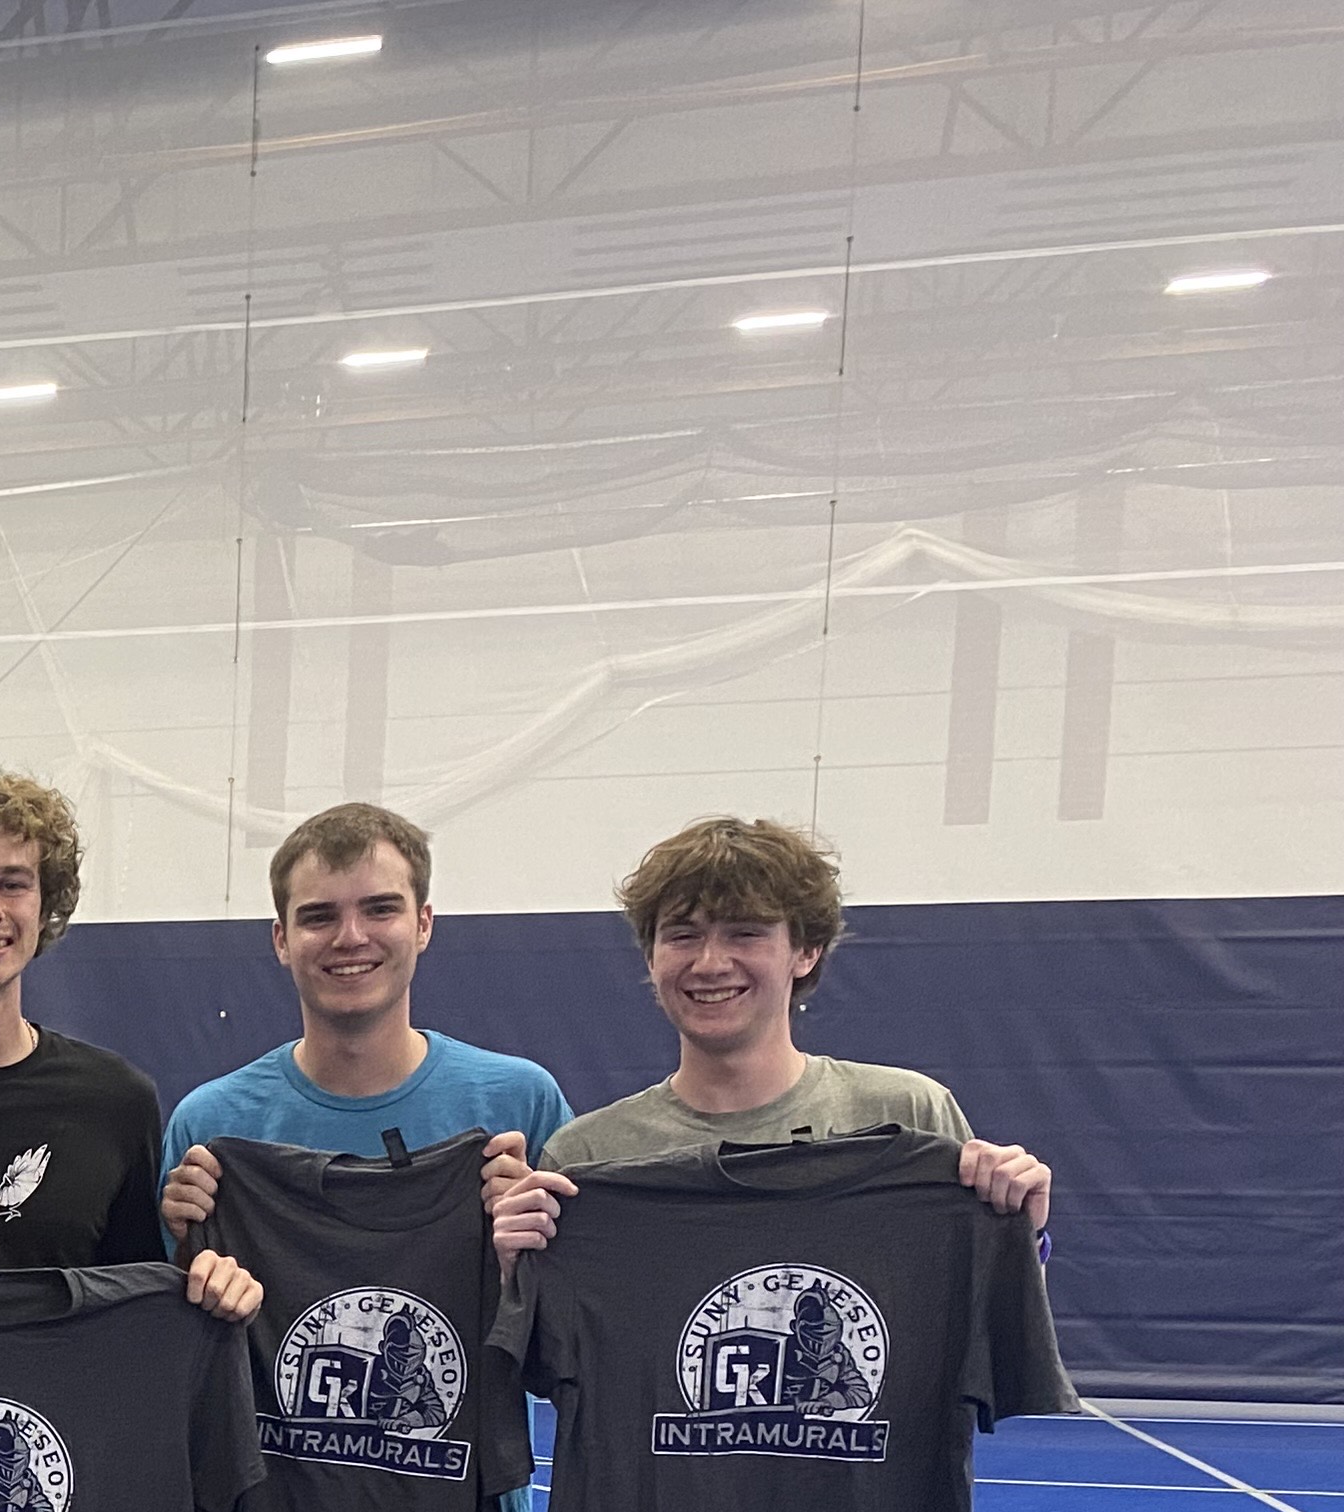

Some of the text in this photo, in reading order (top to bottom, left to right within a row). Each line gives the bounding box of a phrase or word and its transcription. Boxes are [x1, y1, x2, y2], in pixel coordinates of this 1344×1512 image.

[283, 1296, 458, 1384] SUNY GENESEO
[685, 1273, 881, 1361] SUNY GENESEO
[258, 1421, 463, 1471] INTRAMURALS
[659, 1421, 886, 1452] INTRAMURALS
